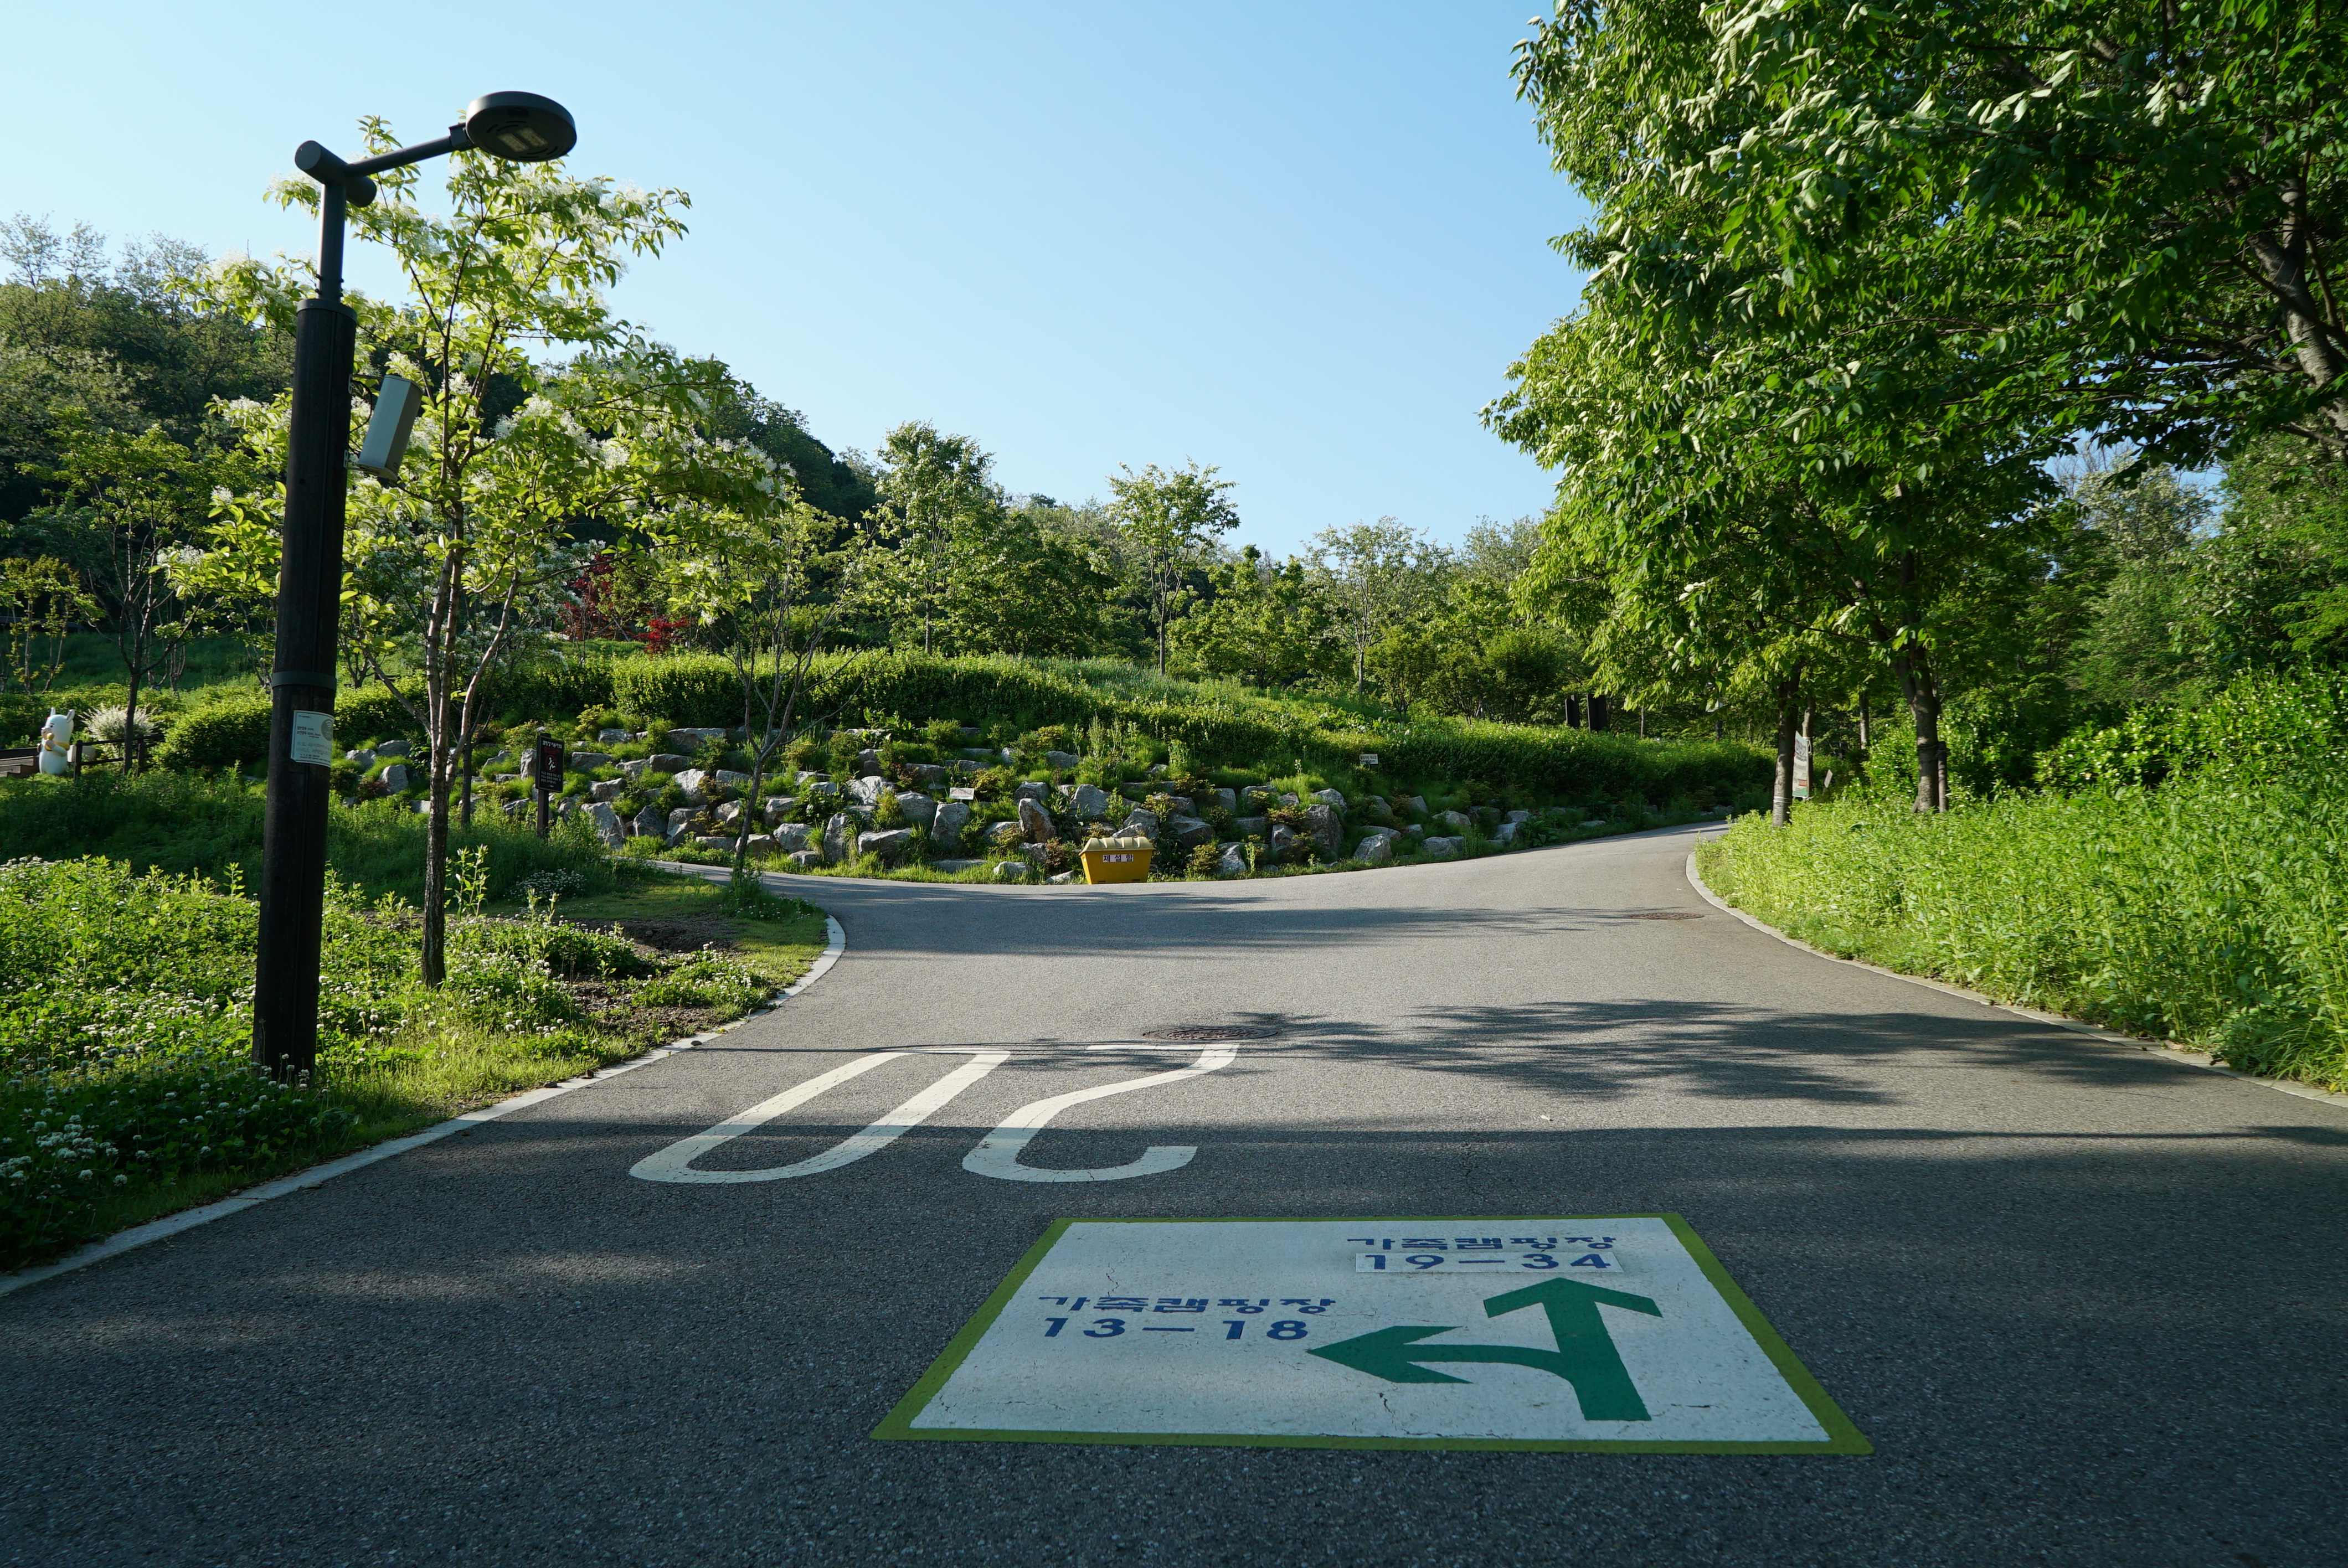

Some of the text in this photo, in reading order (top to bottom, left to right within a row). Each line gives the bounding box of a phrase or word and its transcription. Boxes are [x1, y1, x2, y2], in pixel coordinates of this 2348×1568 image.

[629, 1044, 1240, 1184] 20
[1347, 1236, 1616, 1250] 가족캠핑장
[1038, 1296, 1337, 1314] 가족캠핑장
